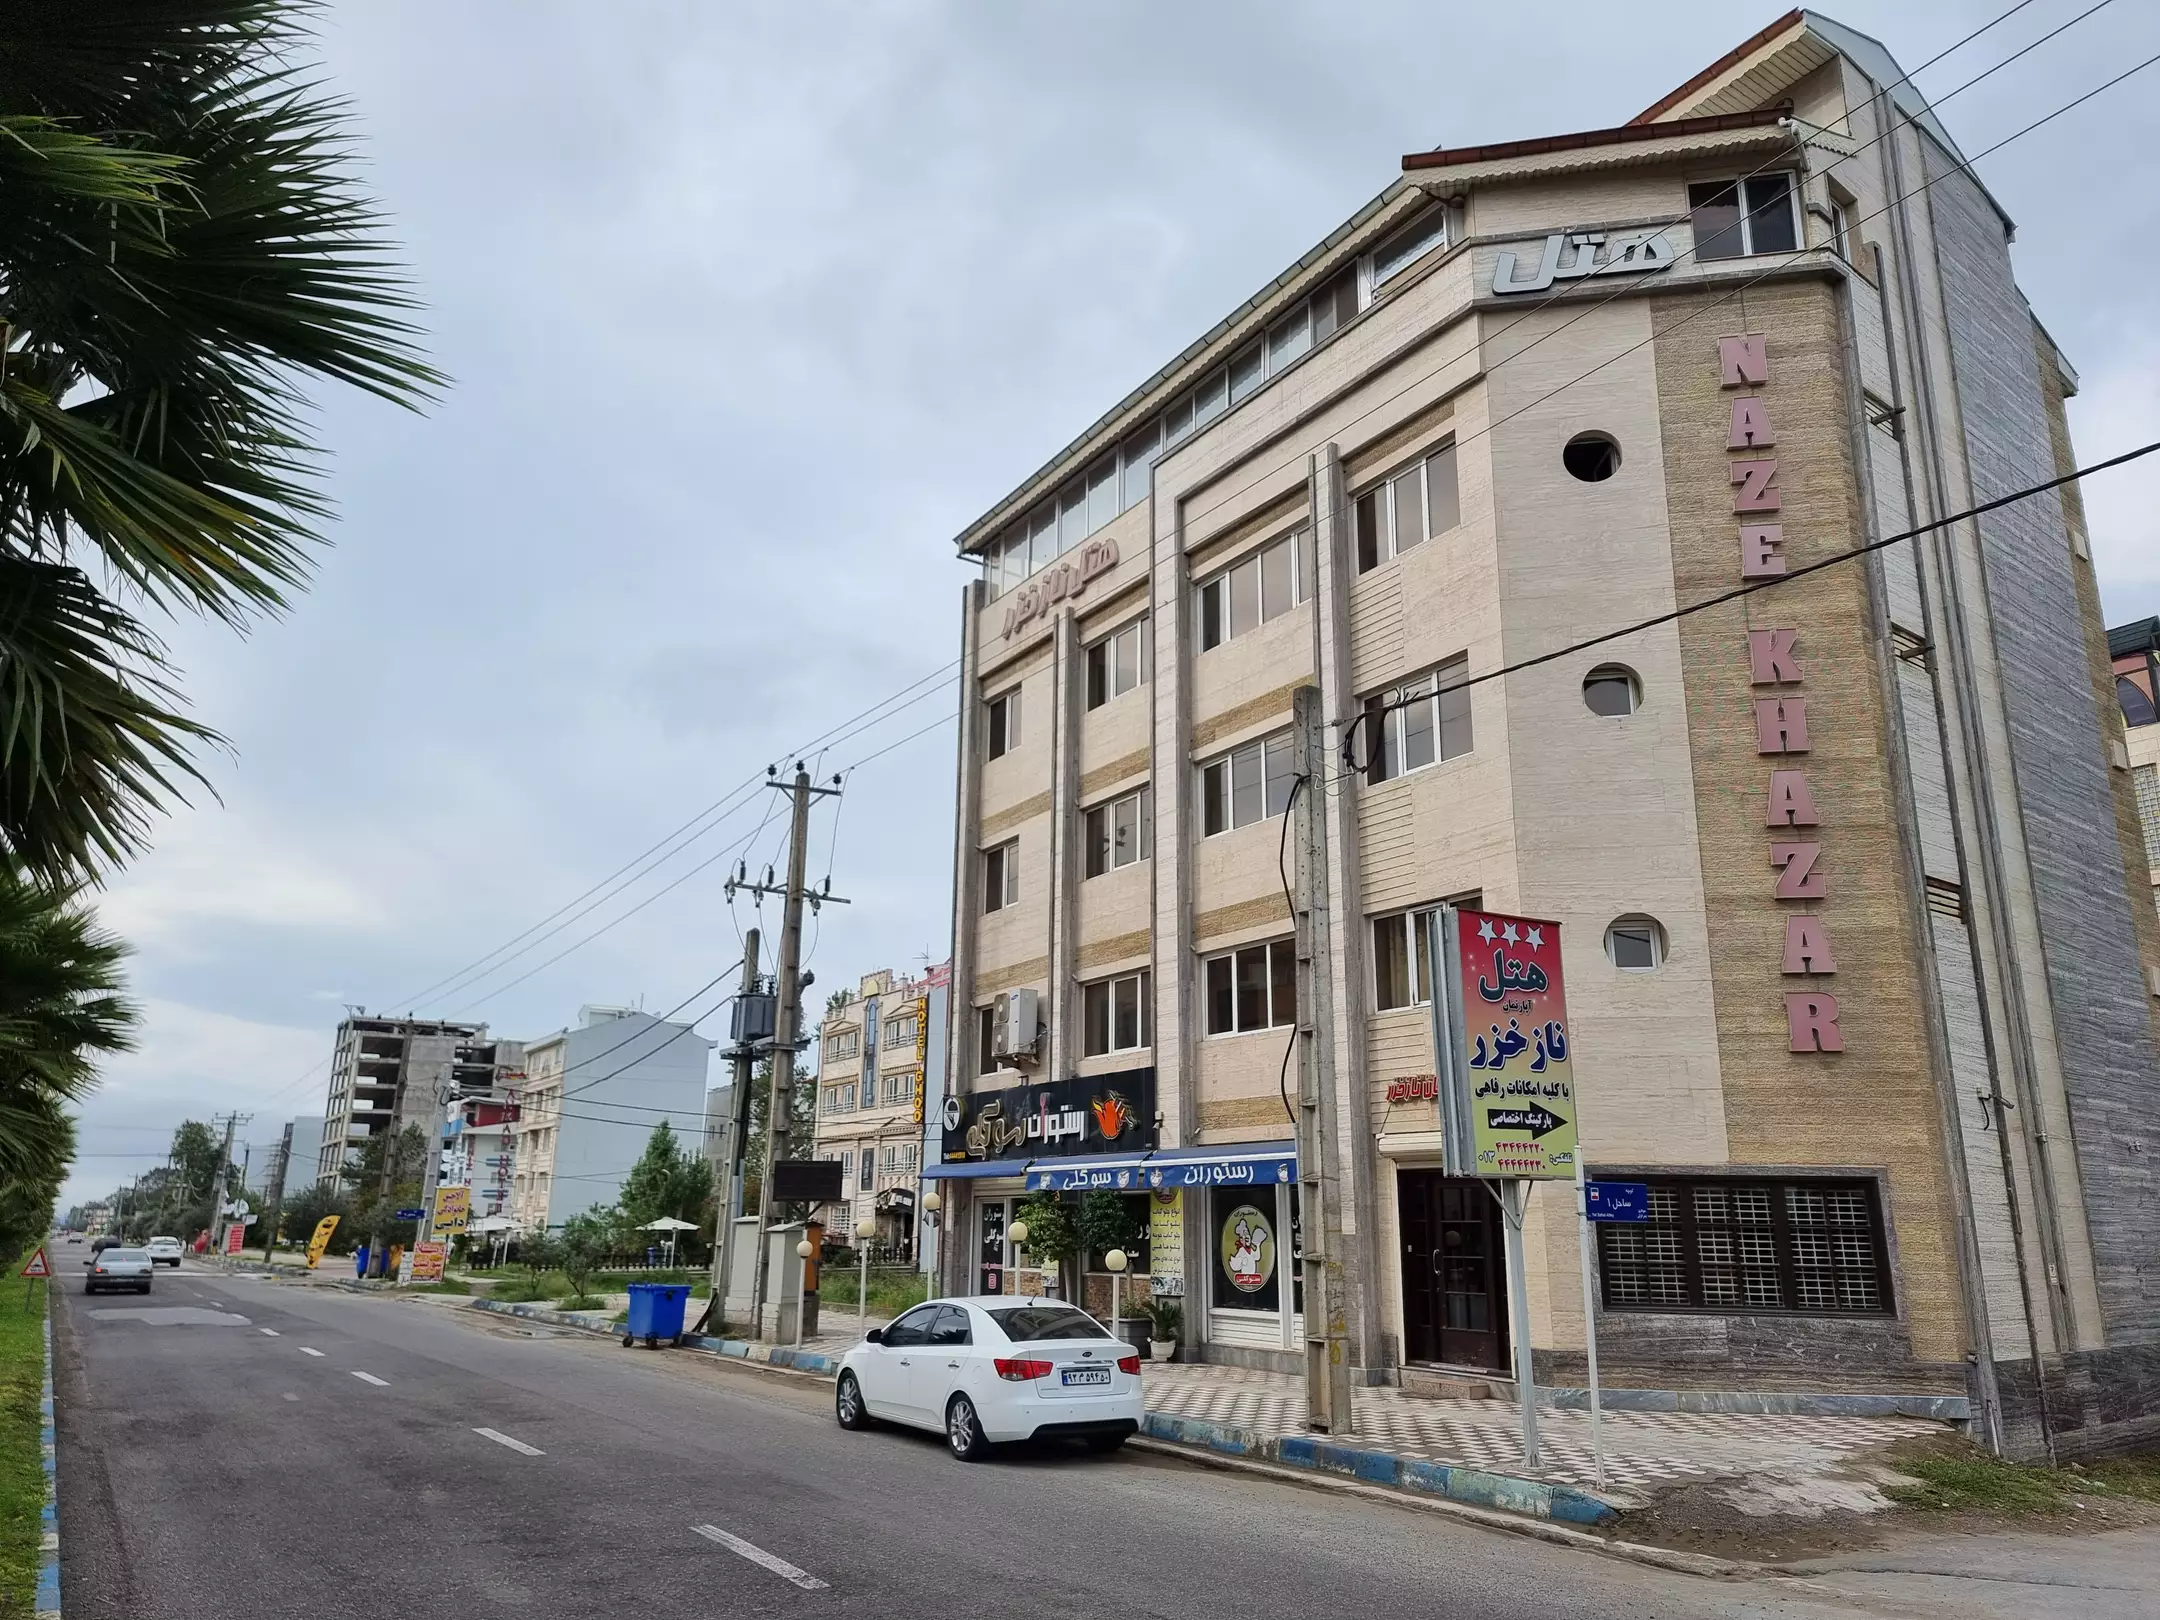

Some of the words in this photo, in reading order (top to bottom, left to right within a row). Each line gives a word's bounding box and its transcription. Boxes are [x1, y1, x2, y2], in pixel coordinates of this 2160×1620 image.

[1492, 233, 1676, 296] هتل
[1717, 332, 1787, 579] NAZE
[1068, 538, 1120, 600] هتل
[1747, 628, 1845, 1054] KHAZAR
[1478, 948, 1549, 1003] هتل
[916, 998, 926, 1061] HOTEL
[1469, 1017, 1528, 1070] خزر
[1528, 1020, 1569, 1073] ناز
[913, 1071, 925, 1123] GHOO
[1474, 1077, 1505, 1099] رفاهی
[1506, 1078, 1541, 1097] امکانات
[1542, 1081, 1560, 1100] کلیه
[1561, 1082, 1570, 1102] با
[1027, 1093, 1086, 1144] رستوران
[1490, 1111, 1524, 1127] اختصاصی
[1524, 1112, 1553, 1129] پارکینگ
[1062, 1169, 1112, 1190] سوگلی
[1183, 1162, 1254, 1184] رستوران
[1612, 1198, 1632, 1211] ساحل
